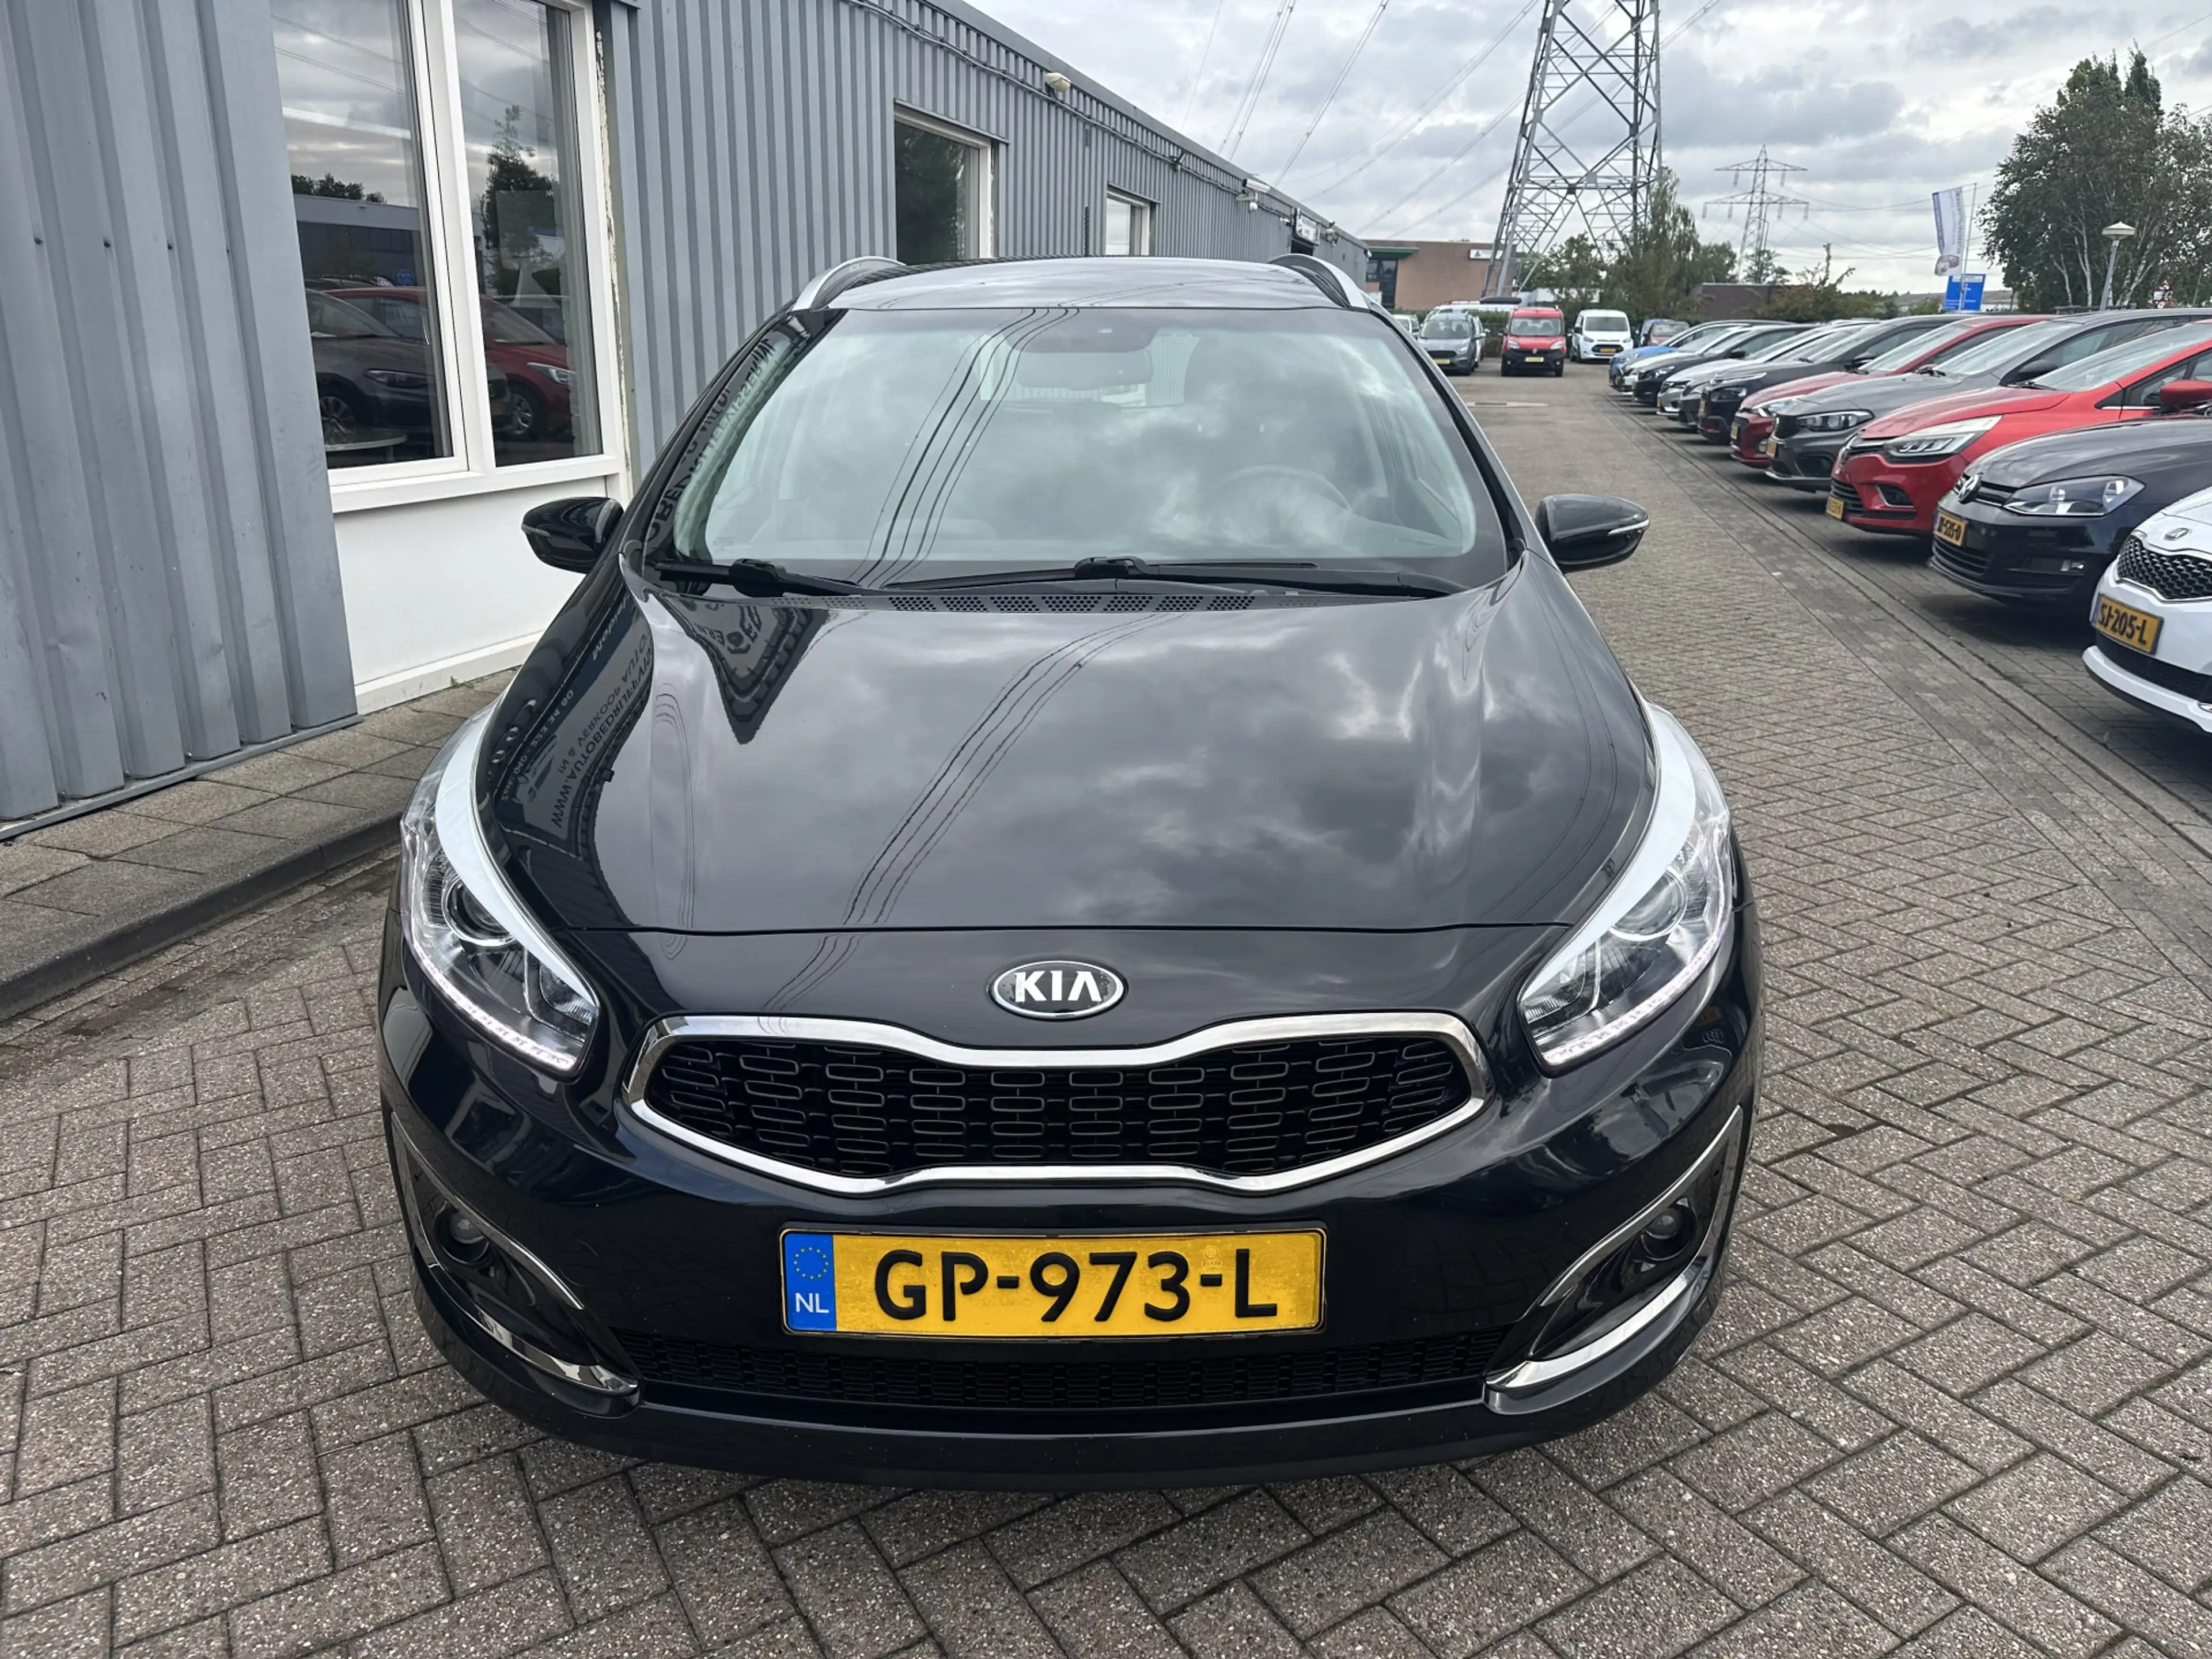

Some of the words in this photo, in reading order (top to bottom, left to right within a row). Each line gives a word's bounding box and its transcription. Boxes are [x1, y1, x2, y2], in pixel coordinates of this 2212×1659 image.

[1014, 970, 1103, 1003] KIA
[874, 1248, 1278, 1322] GP-973-L
[794, 1293, 830, 1314] NL
